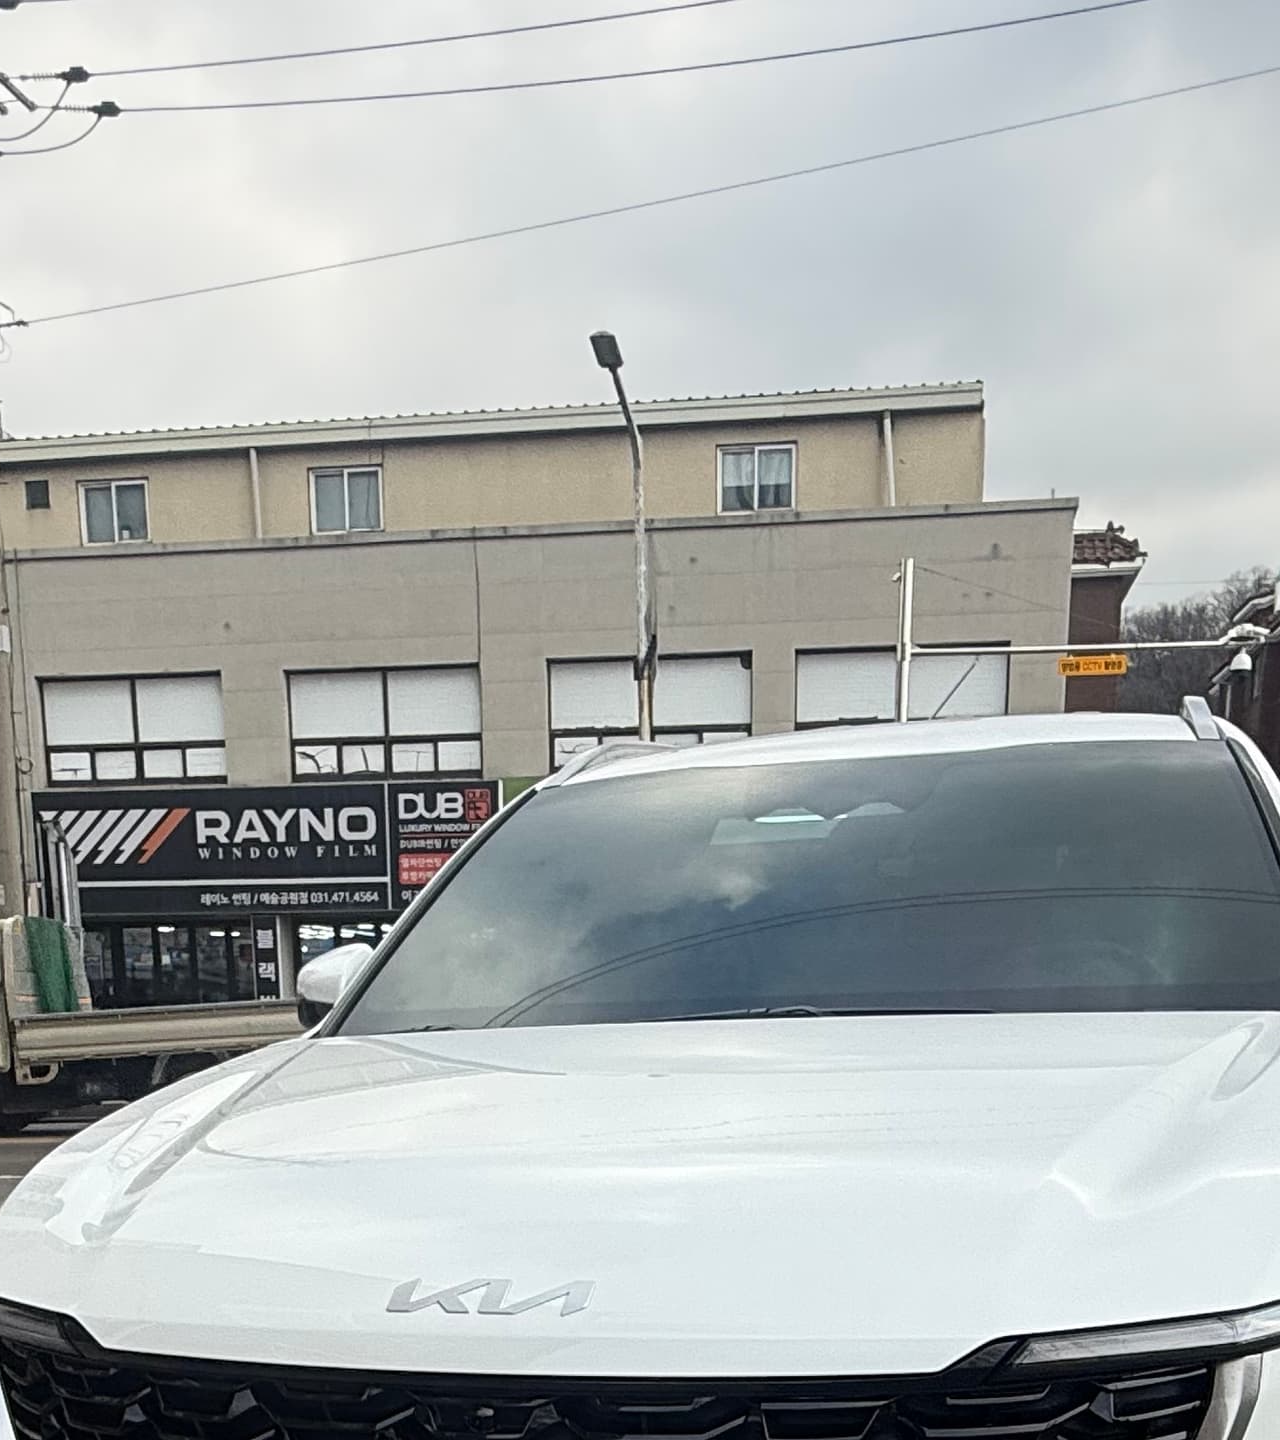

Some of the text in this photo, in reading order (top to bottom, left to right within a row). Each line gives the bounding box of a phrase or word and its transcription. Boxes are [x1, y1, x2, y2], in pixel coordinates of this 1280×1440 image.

[1082, 661, 1103, 672] CCTV
[397, 792, 465, 820] DUB
[195, 806, 377, 845] RAYNO
[398, 823, 433, 833] LUXURY
[433, 823, 470, 833] WINDOW
[198, 844, 377, 860] WINDOW FILM
[256, 929, 277, 1000] 블랙
